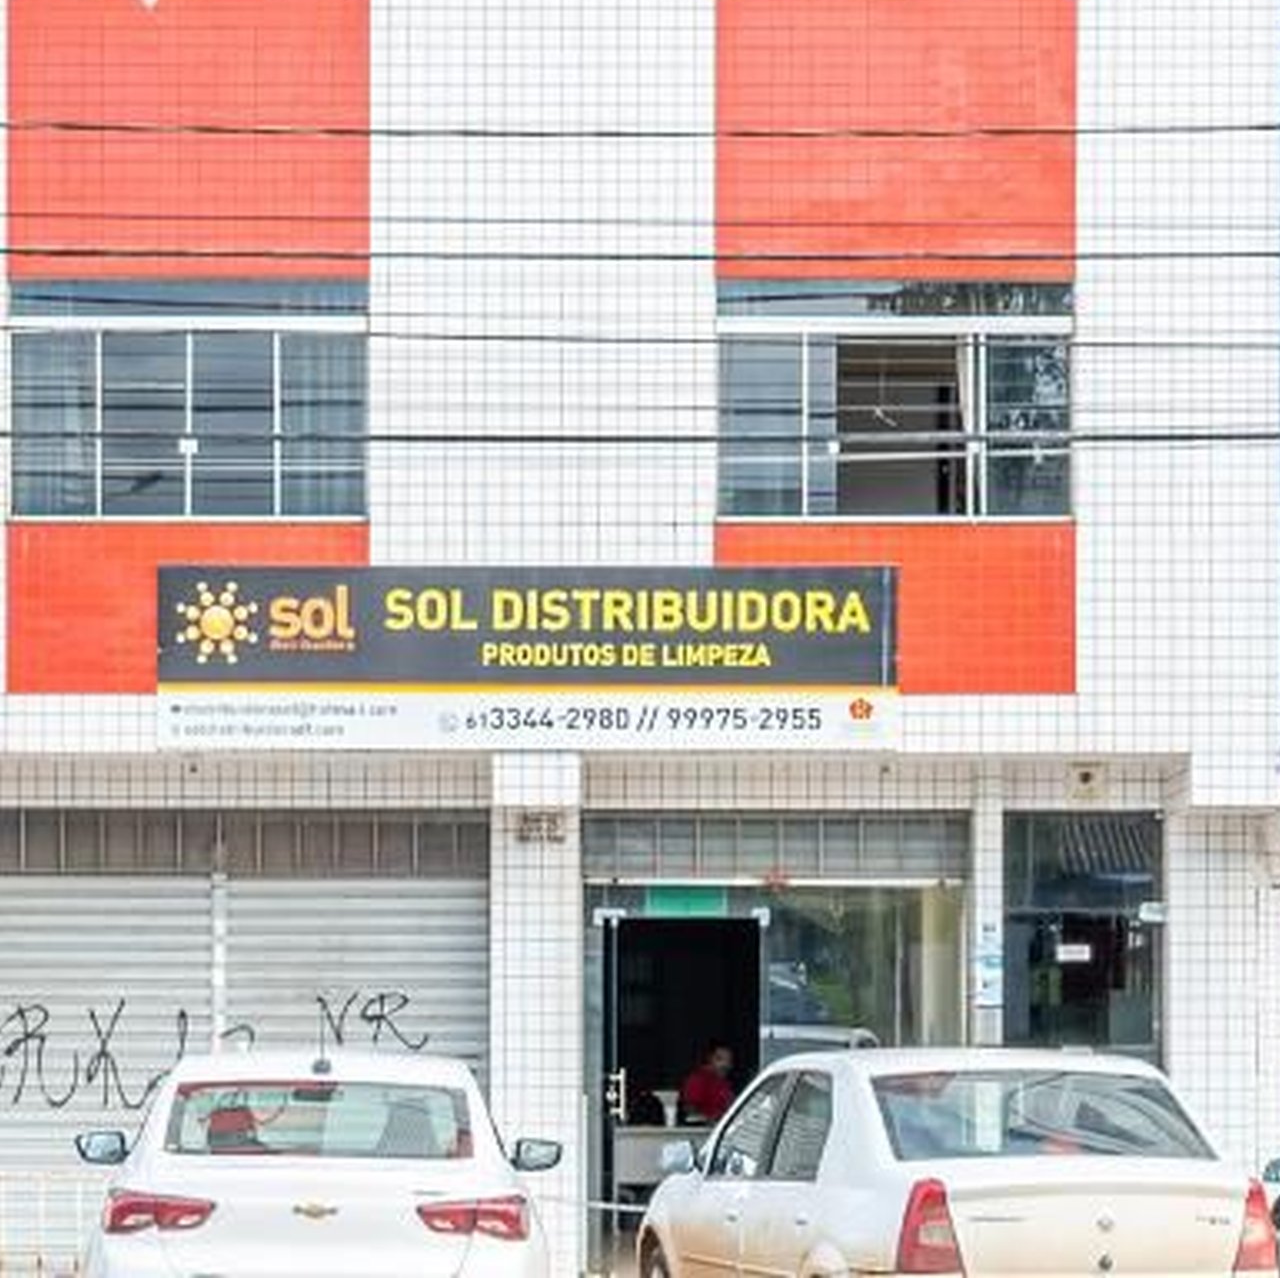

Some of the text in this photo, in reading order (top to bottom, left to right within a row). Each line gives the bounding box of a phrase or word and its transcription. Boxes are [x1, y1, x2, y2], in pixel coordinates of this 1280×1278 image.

[269, 584, 355, 639] sol
[384, 587, 872, 632] SOL DISTRIBUIDORA
[481, 642, 772, 668] PRODUTOS DE LIMPEZA
[666, 706, 822, 730] 99975-2955
